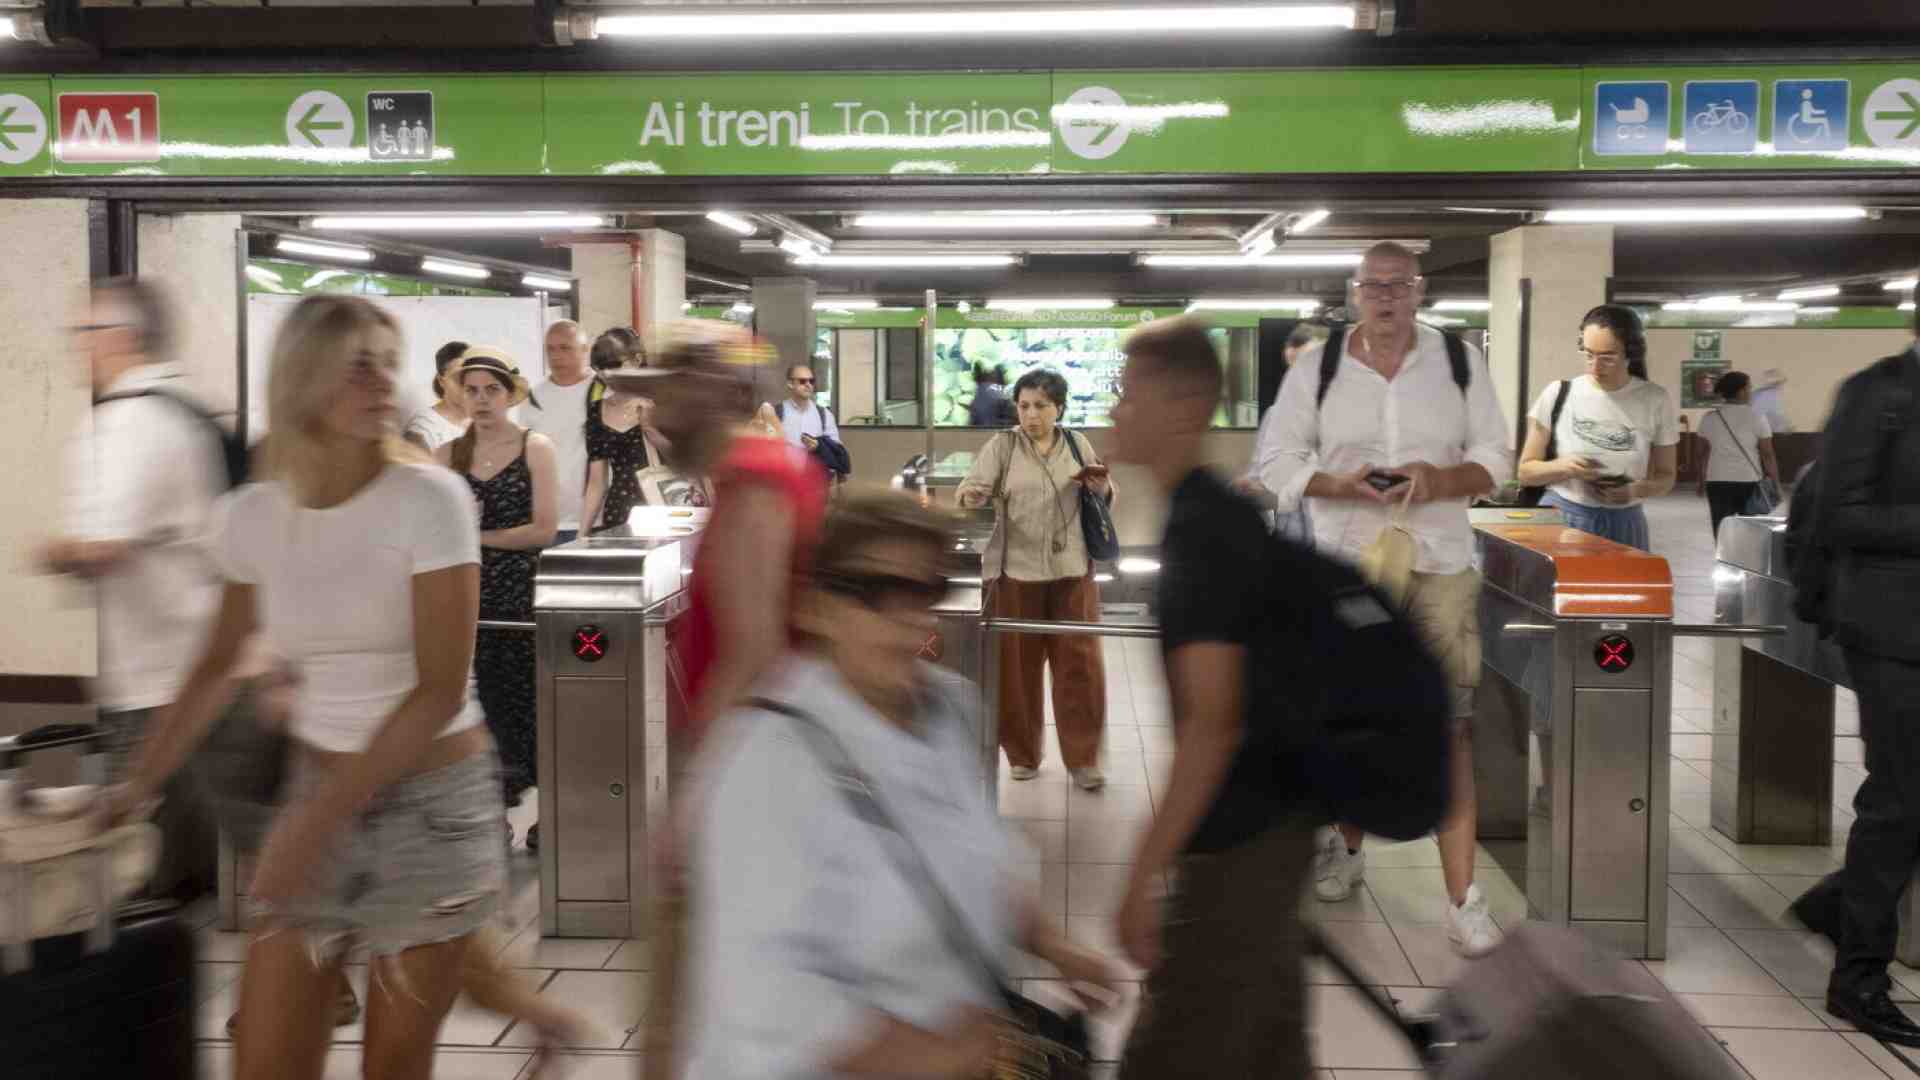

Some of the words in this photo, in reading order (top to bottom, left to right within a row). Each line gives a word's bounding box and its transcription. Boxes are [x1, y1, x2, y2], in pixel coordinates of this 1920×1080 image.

[371, 97, 395, 110] WC
[69, 107, 142, 148] M1
[639, 101, 685, 146] Ai
[697, 101, 809, 146] treni
[832, 101, 890, 145] To
[905, 101, 1041, 145] trains
[1104, 311, 1137, 321] Forum
